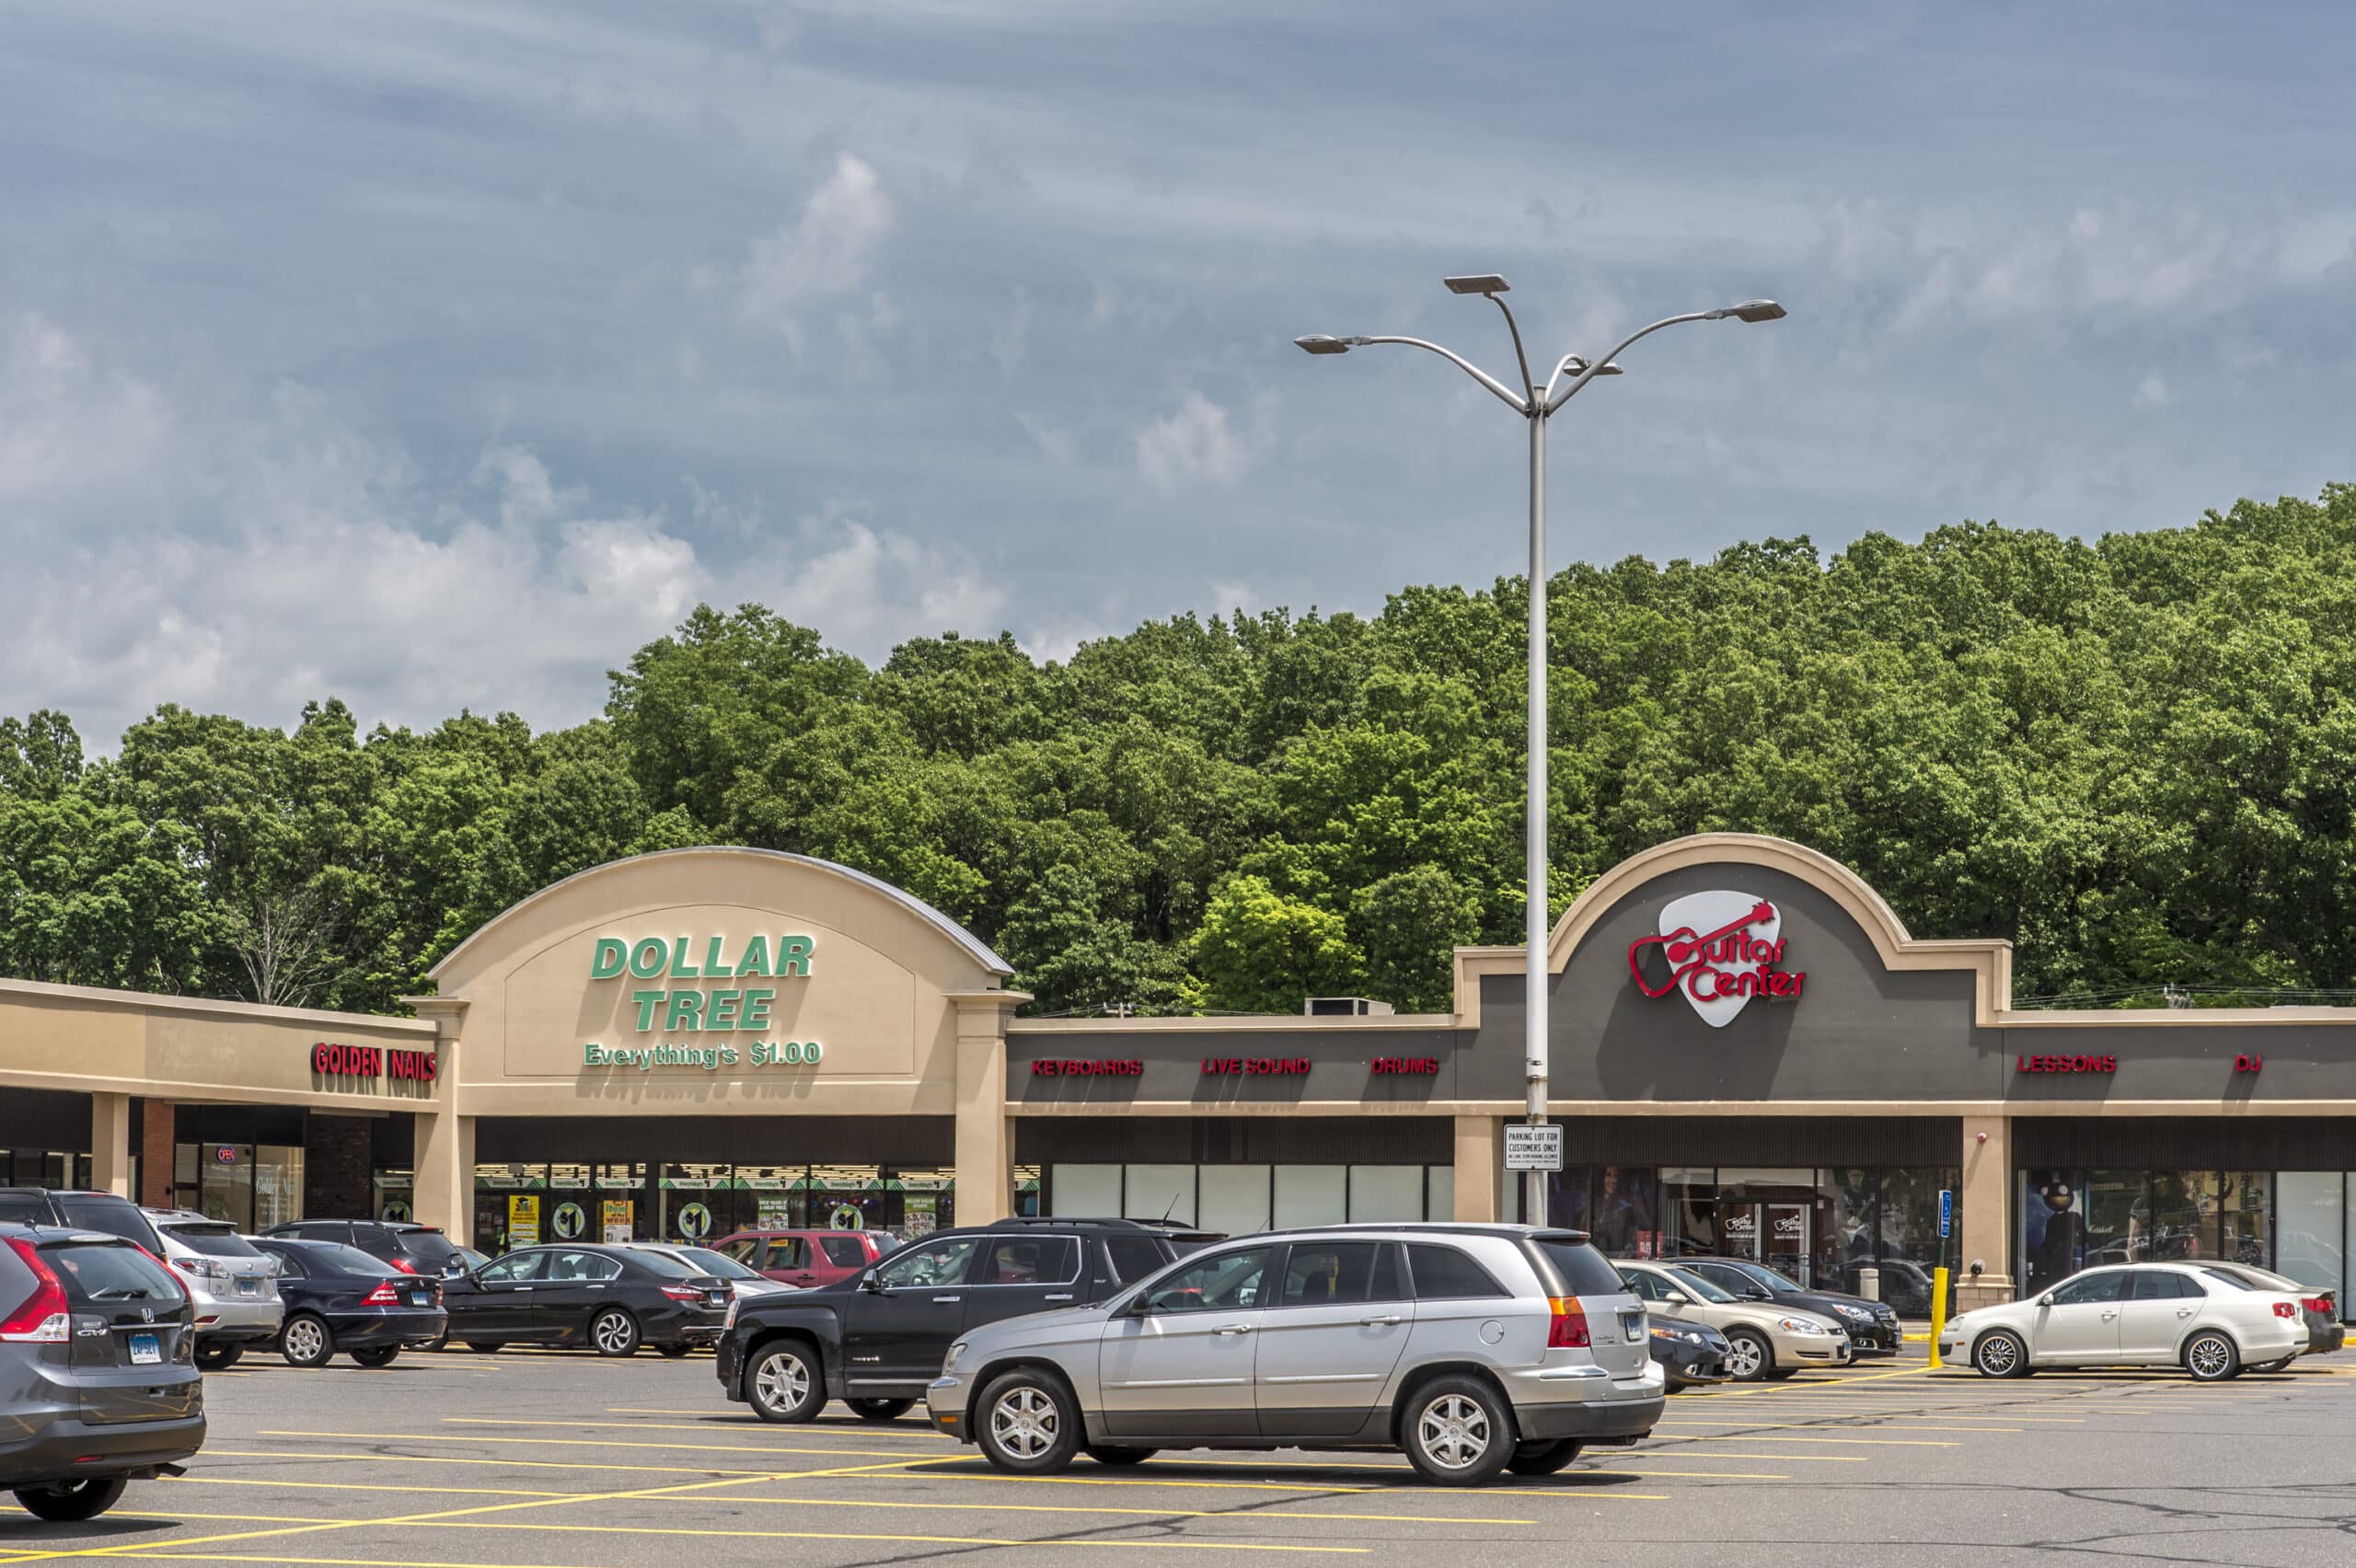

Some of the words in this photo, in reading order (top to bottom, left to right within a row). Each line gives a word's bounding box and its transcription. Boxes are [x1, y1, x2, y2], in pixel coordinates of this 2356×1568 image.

[590, 935, 816, 979] DOLLAR
[1629, 900, 1787, 997] Guitar
[1688, 963, 1807, 1002] Center
[631, 989, 776, 1032] TREE
[312, 1043, 382, 1077] GOLDEN
[389, 1049, 436, 1081] NAILS
[583, 1042, 739, 1070] Everything's
[749, 1040, 825, 1066] $1.00
[2017, 1055, 2117, 1072] LESSONS
[2235, 1054, 2261, 1072] DJ
[1031, 1059, 1144, 1075] KEYBOARDS
[1201, 1058, 1242, 1074] LIVE
[1244, 1058, 1311, 1074] SOUND
[1370, 1057, 1438, 1074] DRUMS
[1509, 1133, 1532, 1141] PARKING
[1535, 1133, 1544, 1141] LOT
[1547, 1133, 1557, 1141] FOR
[218, 1148, 235, 1159] OPEN
[1509, 1144, 1541, 1152] CUSTOMERS
[1543, 1144, 1557, 1152] ONLY
